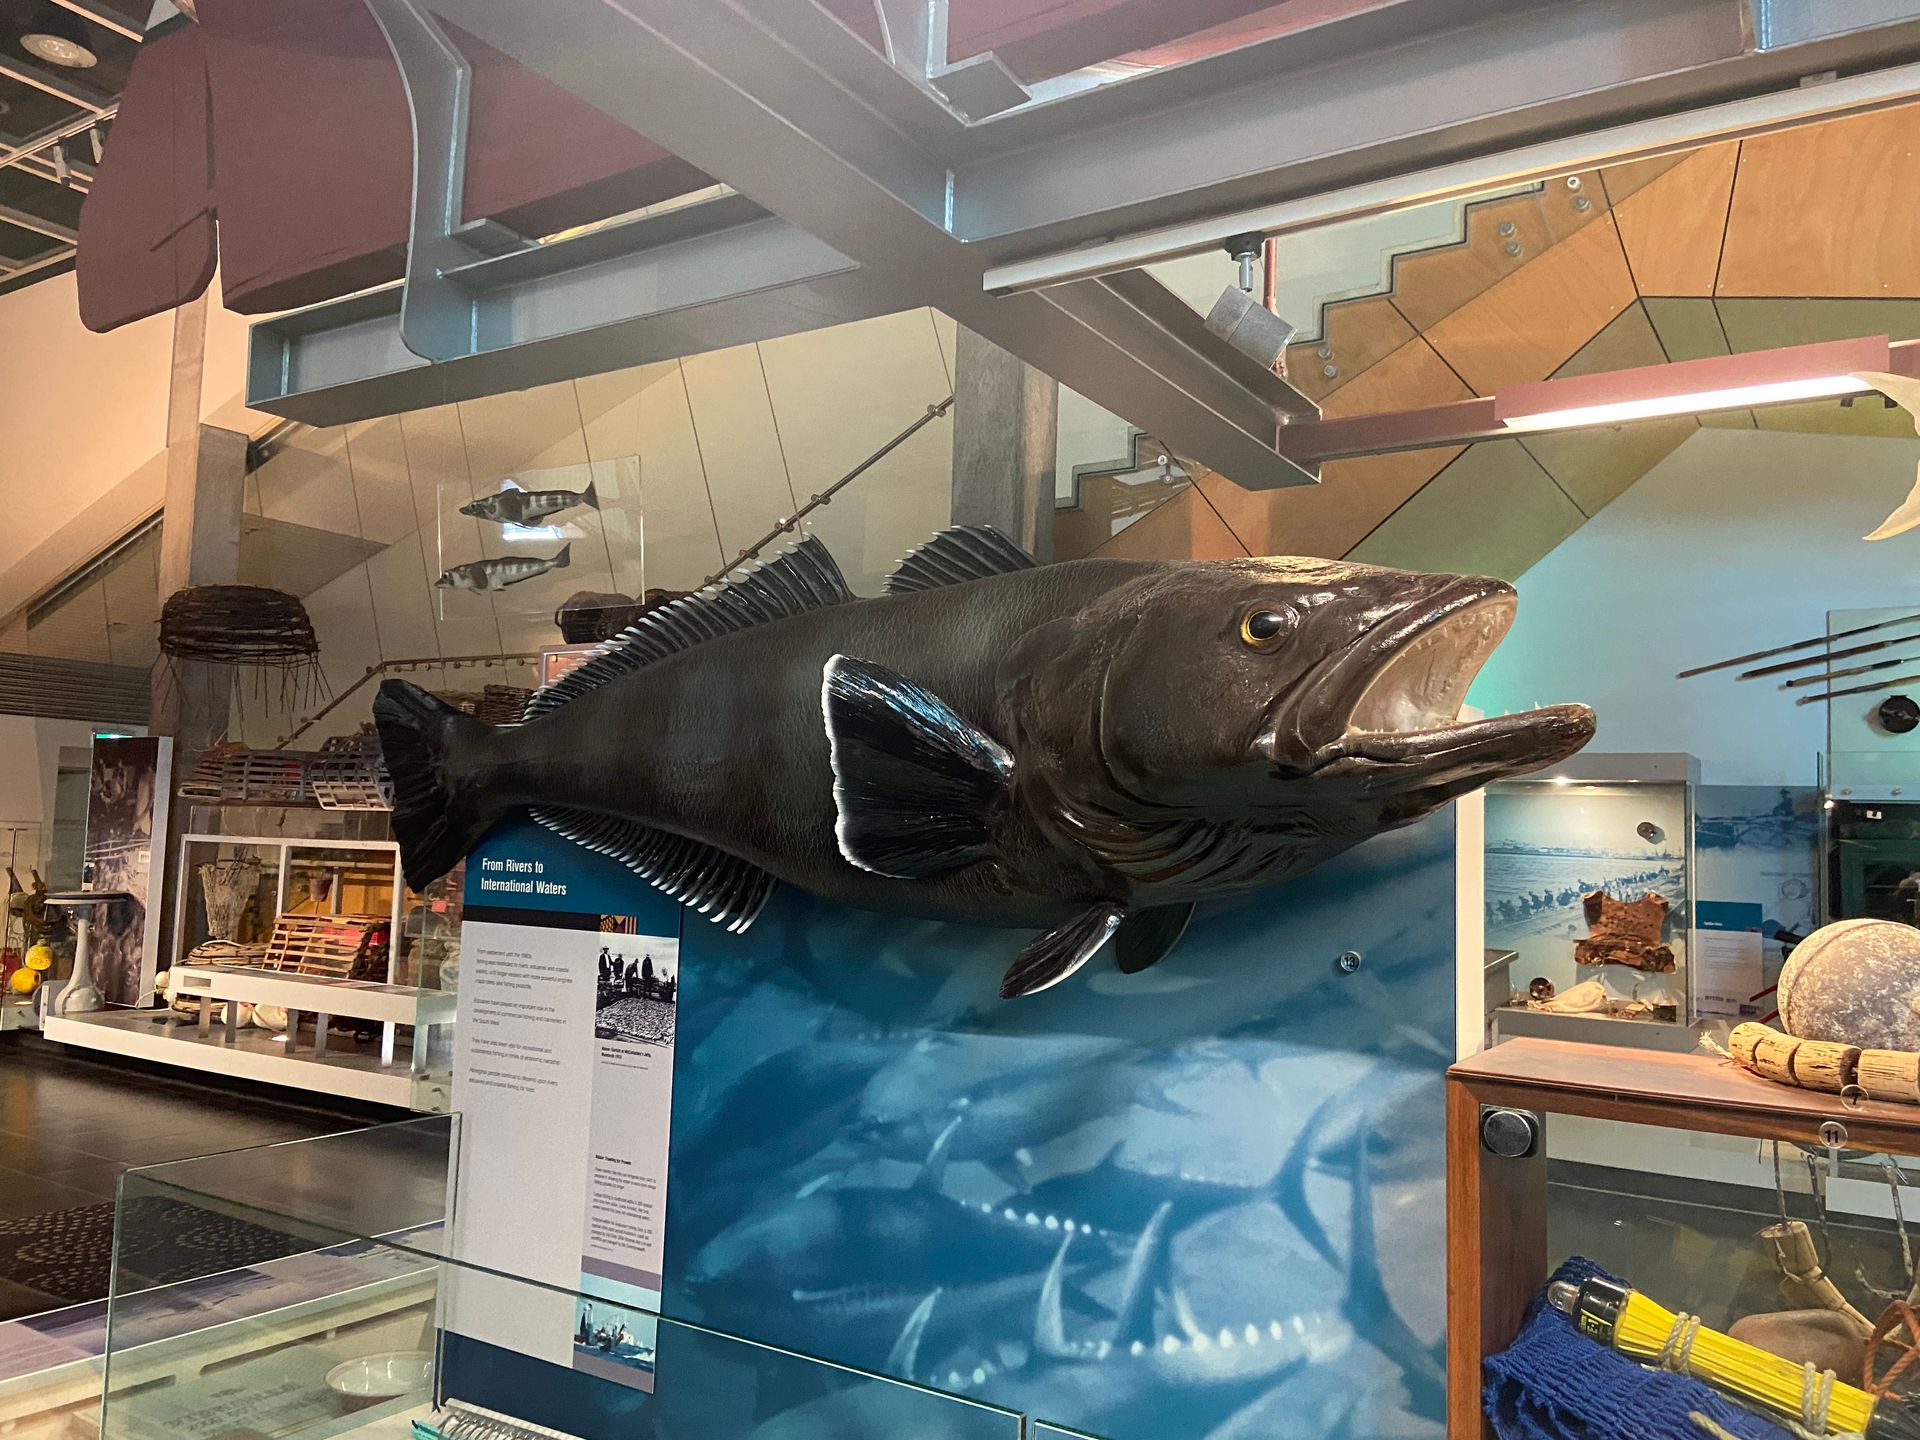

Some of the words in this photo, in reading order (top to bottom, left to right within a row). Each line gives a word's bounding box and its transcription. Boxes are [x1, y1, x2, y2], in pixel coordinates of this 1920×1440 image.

[482, 858, 503, 871] From
[506, 859, 532, 873] Rivers
[535, 861, 543, 874] to
[481, 878, 533, 893] International
[536, 881, 567, 895] Waters
[1344, 956, 1355, 967] 13
[1824, 1129, 1839, 1144] 11
